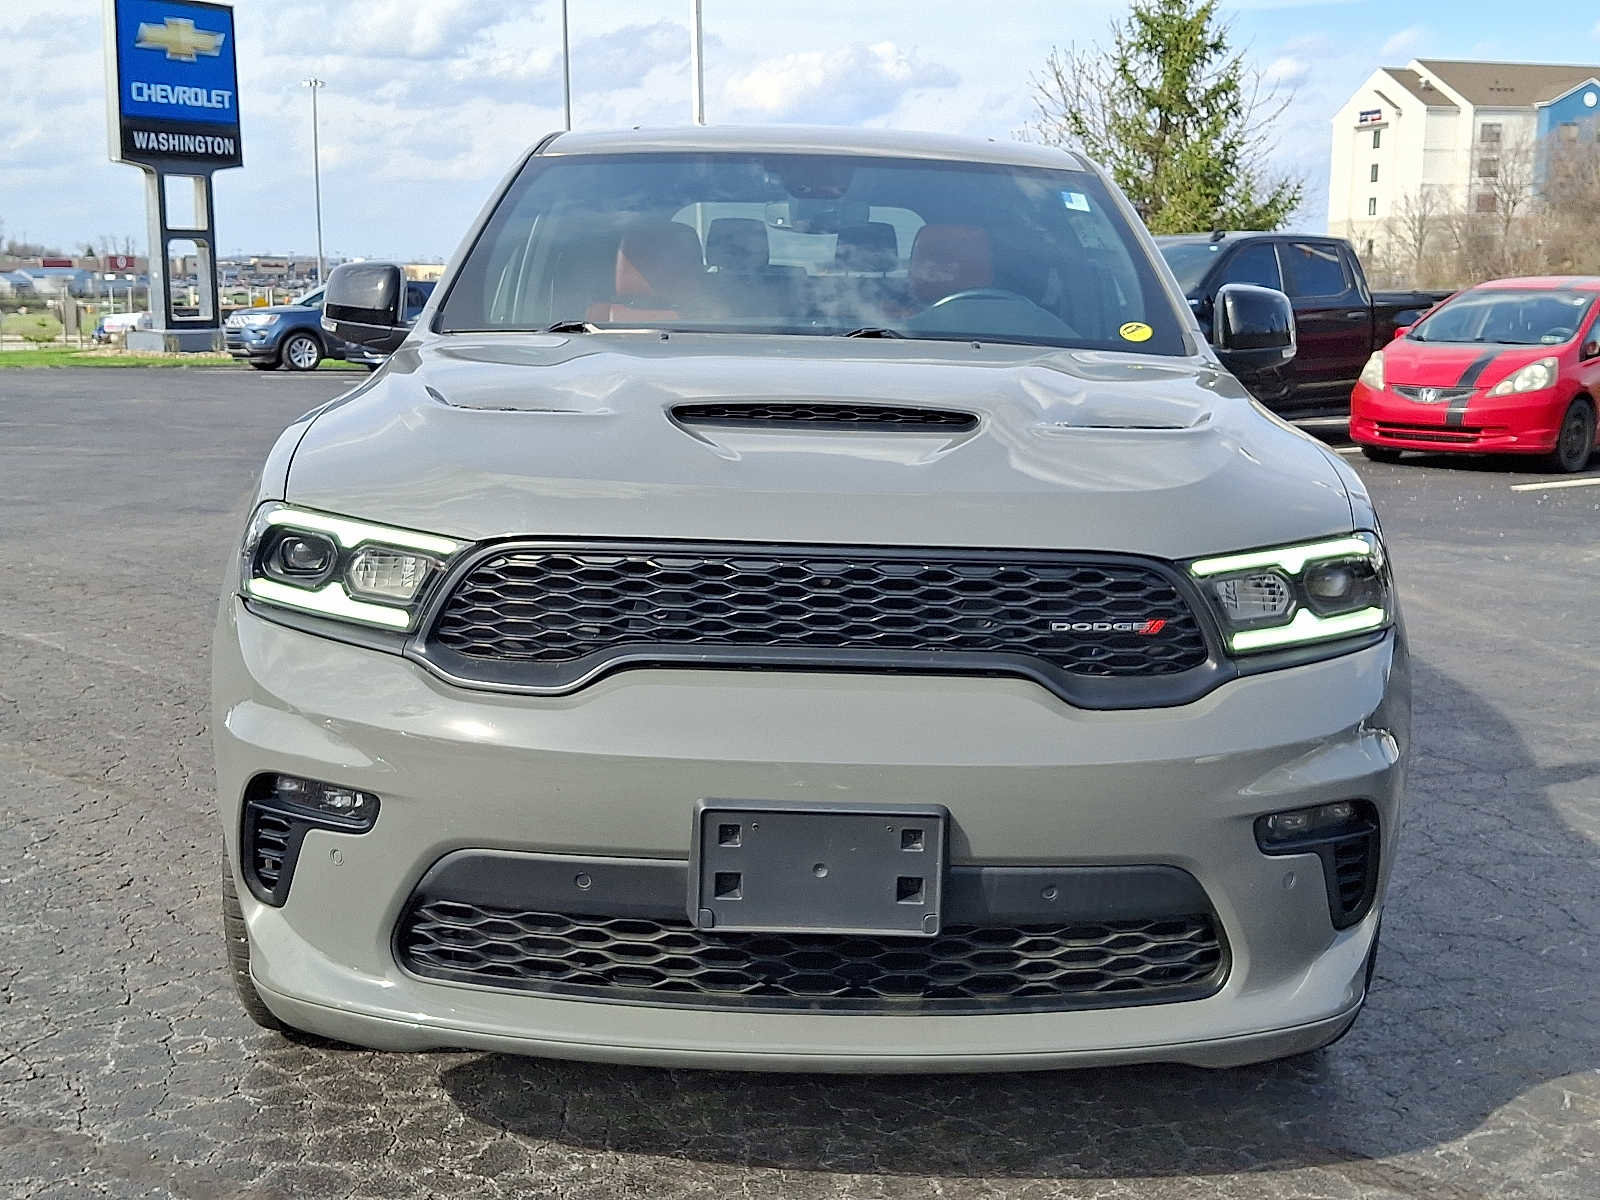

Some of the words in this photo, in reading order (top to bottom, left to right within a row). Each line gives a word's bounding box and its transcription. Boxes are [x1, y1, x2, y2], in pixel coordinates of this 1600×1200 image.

[131, 81, 232, 109] CHEVROLET
[132, 130, 235, 155] WASHINGTON
[1051, 622, 1151, 632] DODGE
